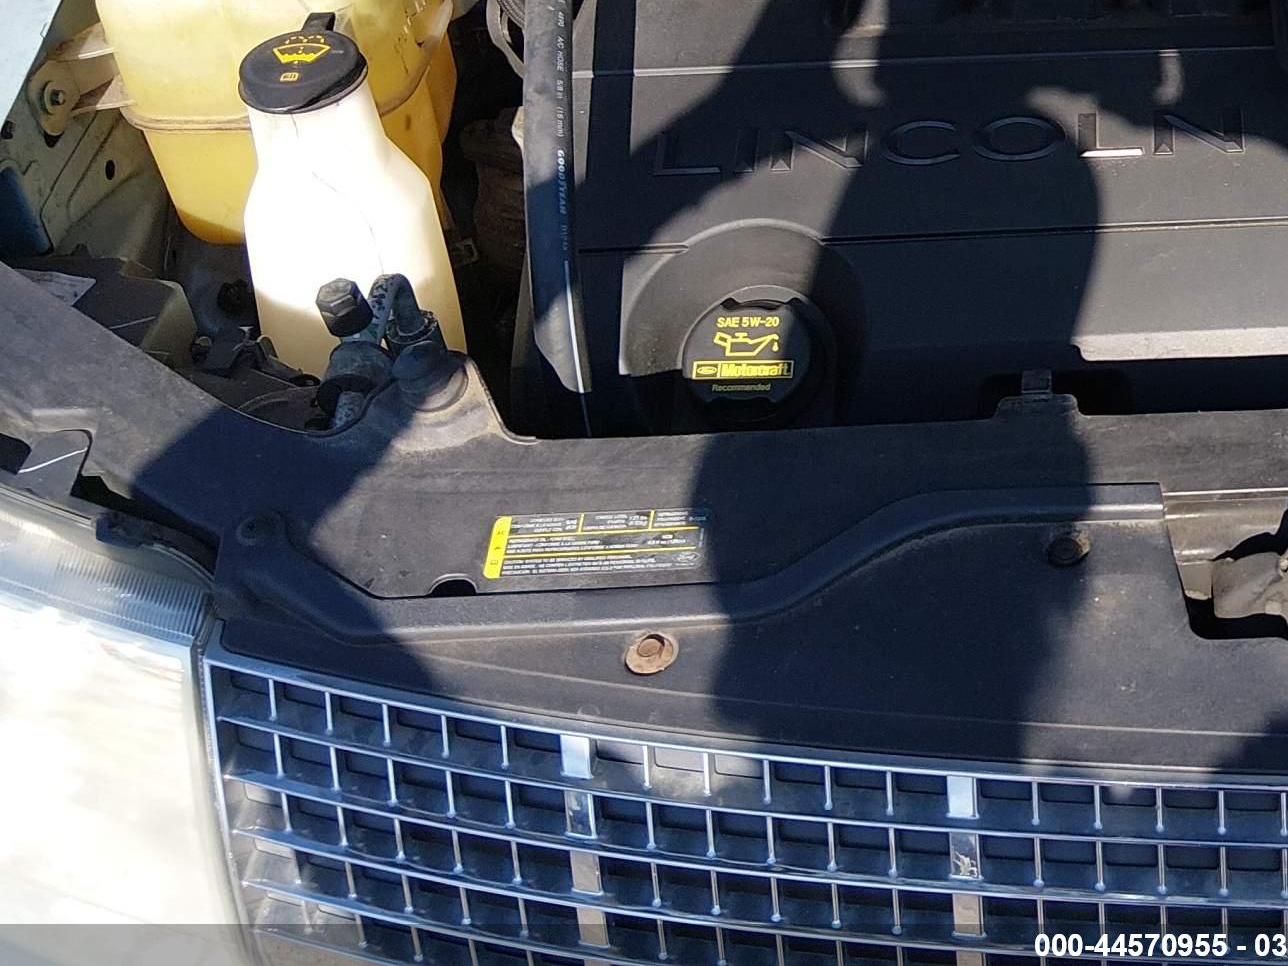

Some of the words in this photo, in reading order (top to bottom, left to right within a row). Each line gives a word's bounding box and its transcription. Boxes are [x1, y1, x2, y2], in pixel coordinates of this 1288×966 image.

[556, 51, 565, 72] HOSE
[652, 108, 1246, 177] LINCOLN
[717, 316, 740, 328] SAE
[741, 316, 780, 328] 5W-20
[720, 363, 789, 377] Motorcraft
[711, 383, 771, 391] Recommended
